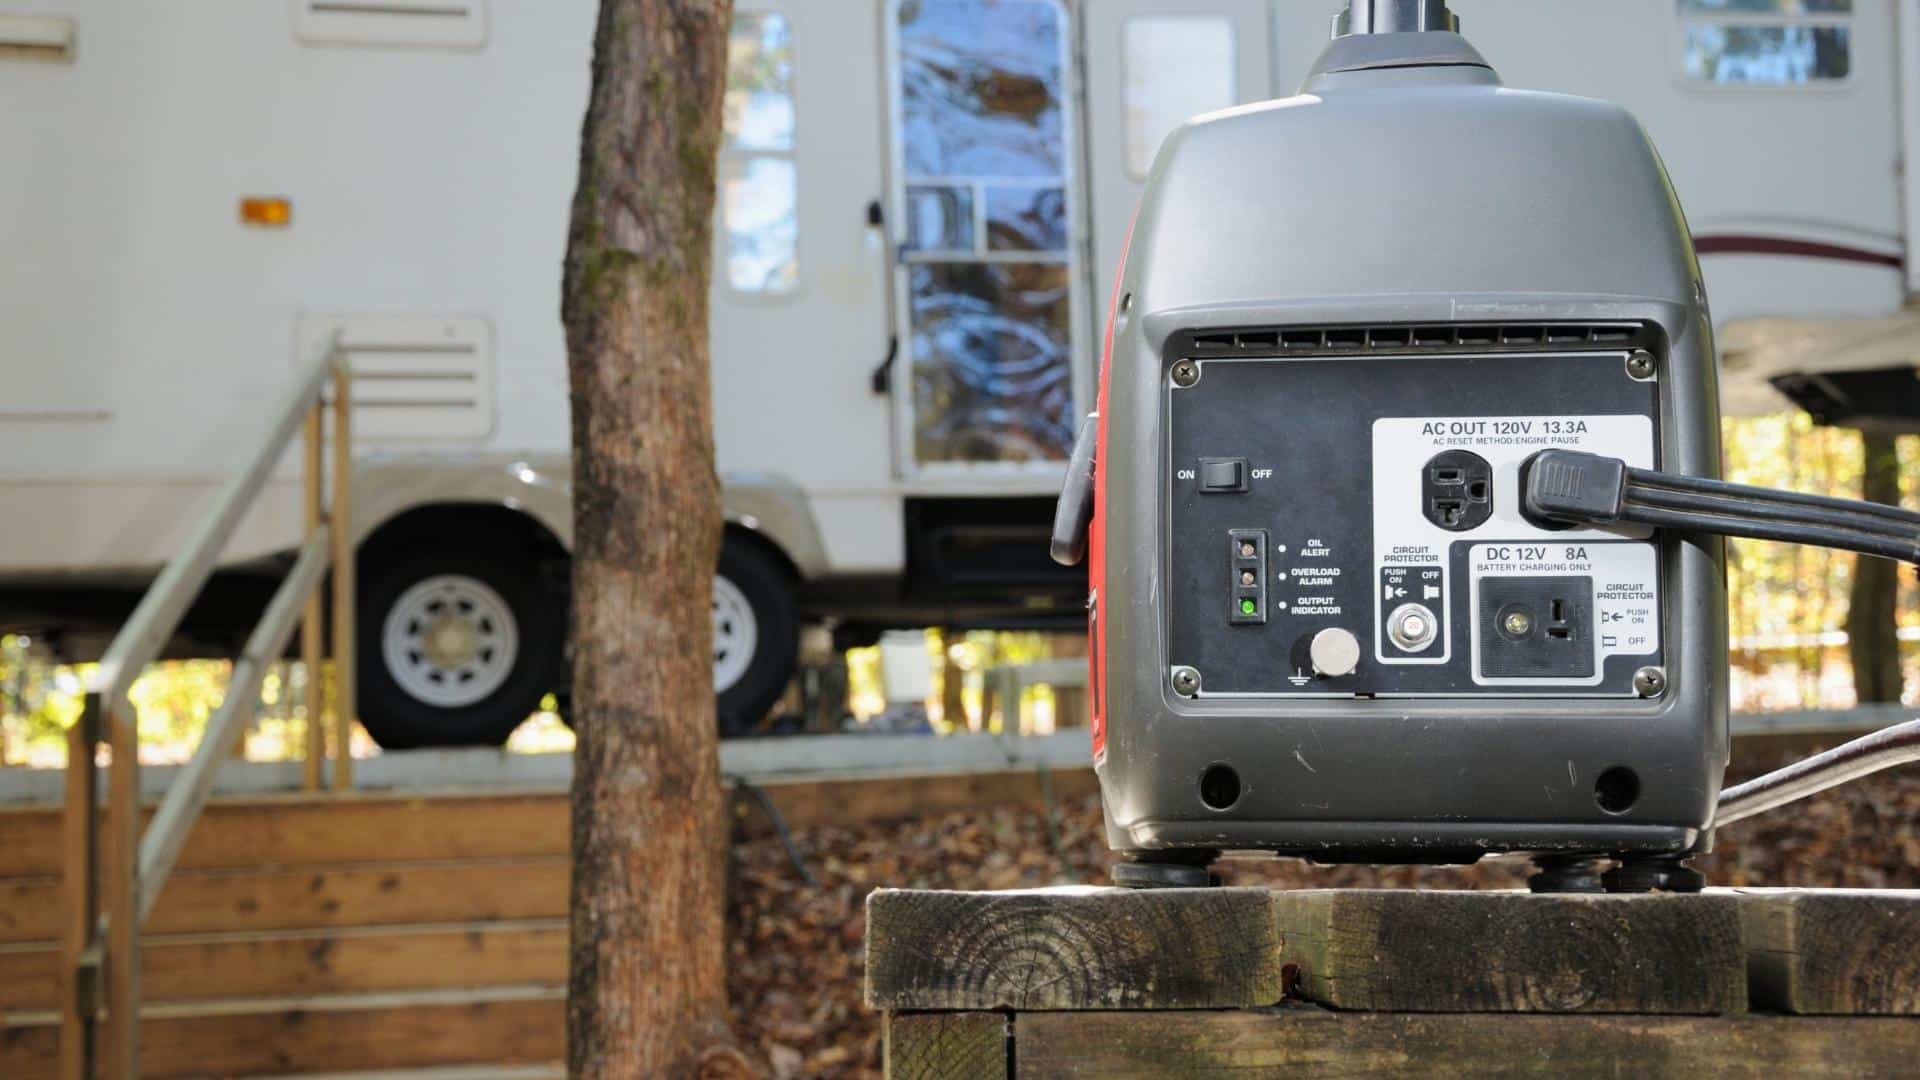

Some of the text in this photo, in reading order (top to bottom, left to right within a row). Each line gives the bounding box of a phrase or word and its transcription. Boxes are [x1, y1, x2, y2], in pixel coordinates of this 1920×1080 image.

[1422, 421, 1588, 435] AC OUT 120V 13.3A
[1551, 436, 1580, 444] PAUSE
[1177, 470, 1195, 480] ON
[1251, 469, 1273, 479] OFF
[1307, 539, 1323, 547] OIL
[1301, 548, 1330, 556] ALERT
[1392, 546, 1429, 554] CIRCUIT
[1486, 547, 1588, 561] DC 12V 8A
[1383, 554, 1439, 562] PROTECTOR
[1291, 567, 1341, 576] OVERLOAD
[1477, 563, 1592, 572] BATTERY CHARGING ONLY
[1384, 568, 1407, 576] PUSH
[1422, 571, 1440, 579] OFF
[1606, 583, 1644, 591] CIRCUIT
[1597, 592, 1654, 600] PROTECTOR
[1298, 597, 1334, 605] OUTPUT
[1291, 605, 1341, 614] INDICATOR
[1626, 608, 1648, 616] PUSH
[1628, 637, 1645, 645] OFF
